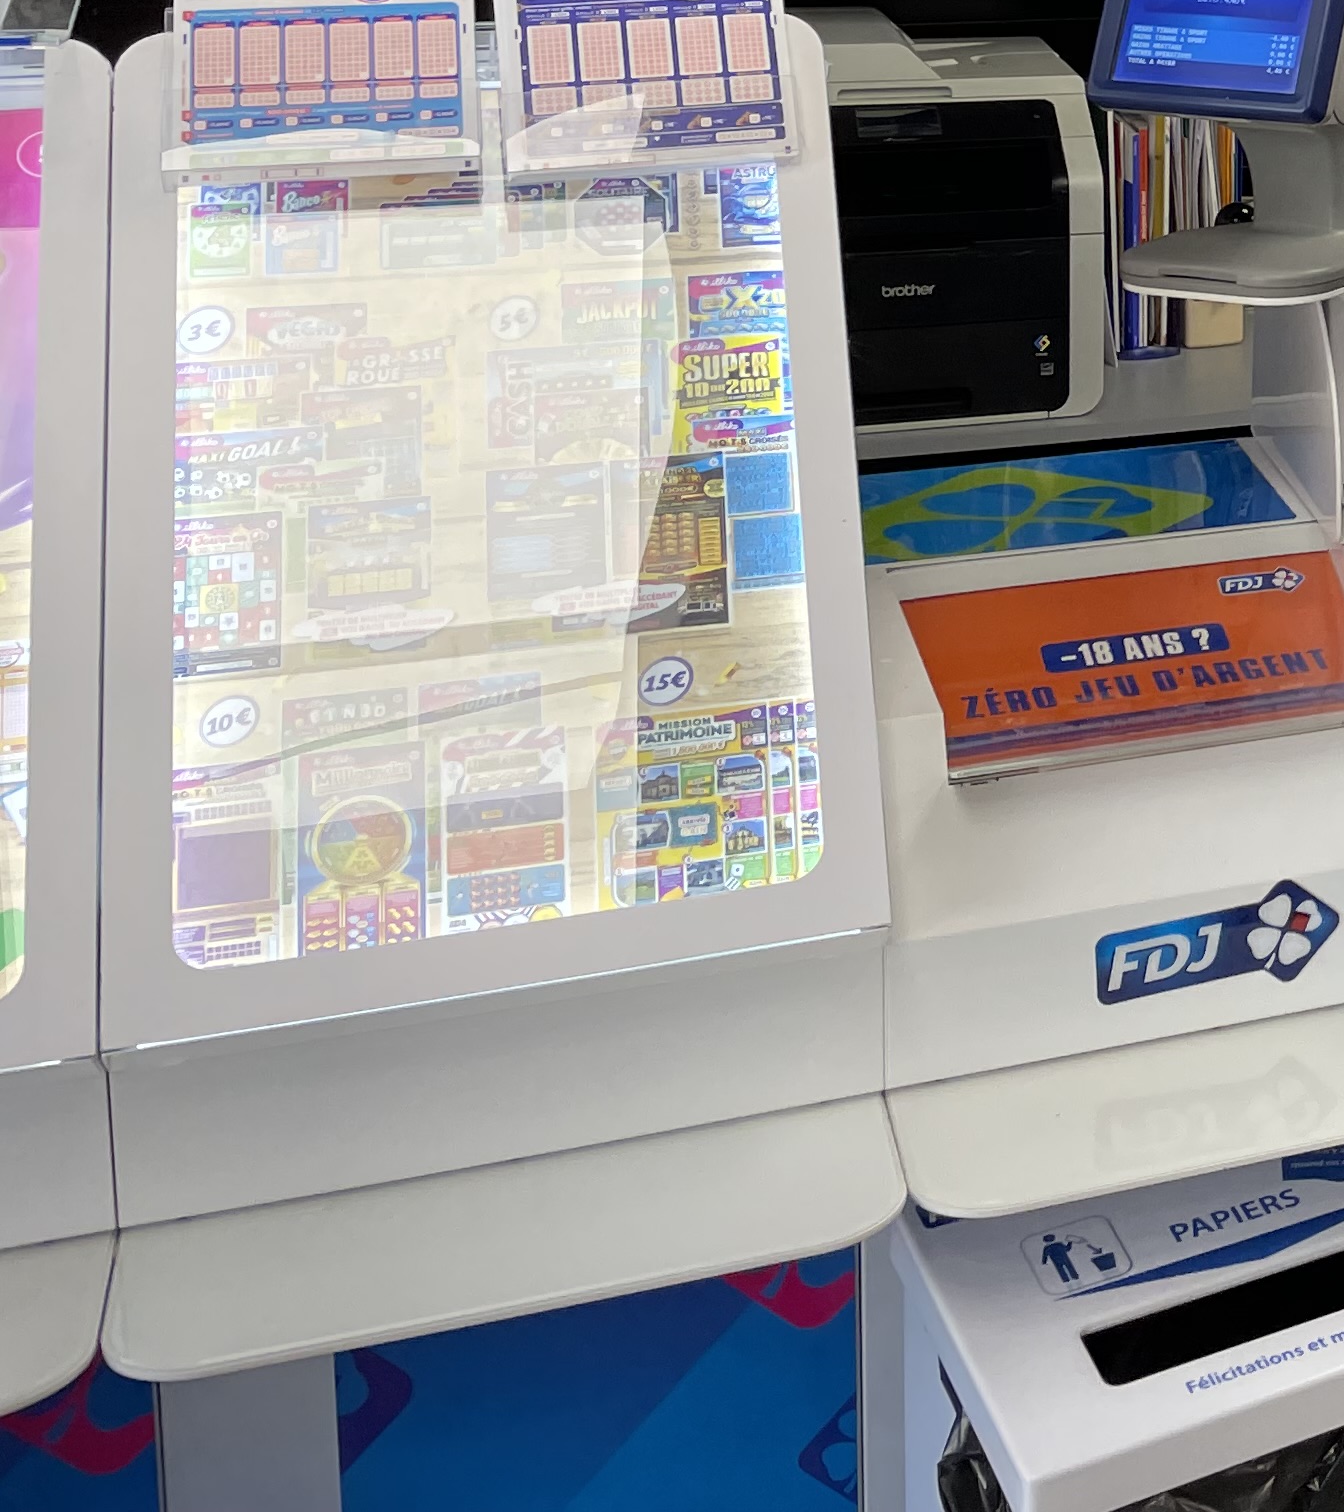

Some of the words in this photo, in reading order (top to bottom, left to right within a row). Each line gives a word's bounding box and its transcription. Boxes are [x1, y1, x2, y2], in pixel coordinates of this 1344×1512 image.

[881, 282, 936, 299] brother
[188, 319, 223, 342] 3€
[682, 351, 771, 382] SUPER
[226, 436, 290, 464] GOAL
[1225, 574, 1264, 594] FDJ
[1059, 640, 1115, 667] -18
[1123, 631, 1183, 662] ANS
[1192, 628, 1212, 652] ?
[643, 670, 687, 693] 15€
[960, 684, 1060, 720] ZÉRO
[1074, 672, 1143, 706] JEU
[1152, 646, 1330, 694] D'ARGENT
[206, 709, 251, 733] 10€
[658, 716, 712, 730] MISSION
[637, 724, 733, 745] PATRIMOINE
[1106, 922, 1227, 994] FDJ
[1168, 1188, 1302, 1244] PAPIERS
[1185, 1341, 1306, 1396] Félicitations
[1307, 1335, 1330, 1356] et
